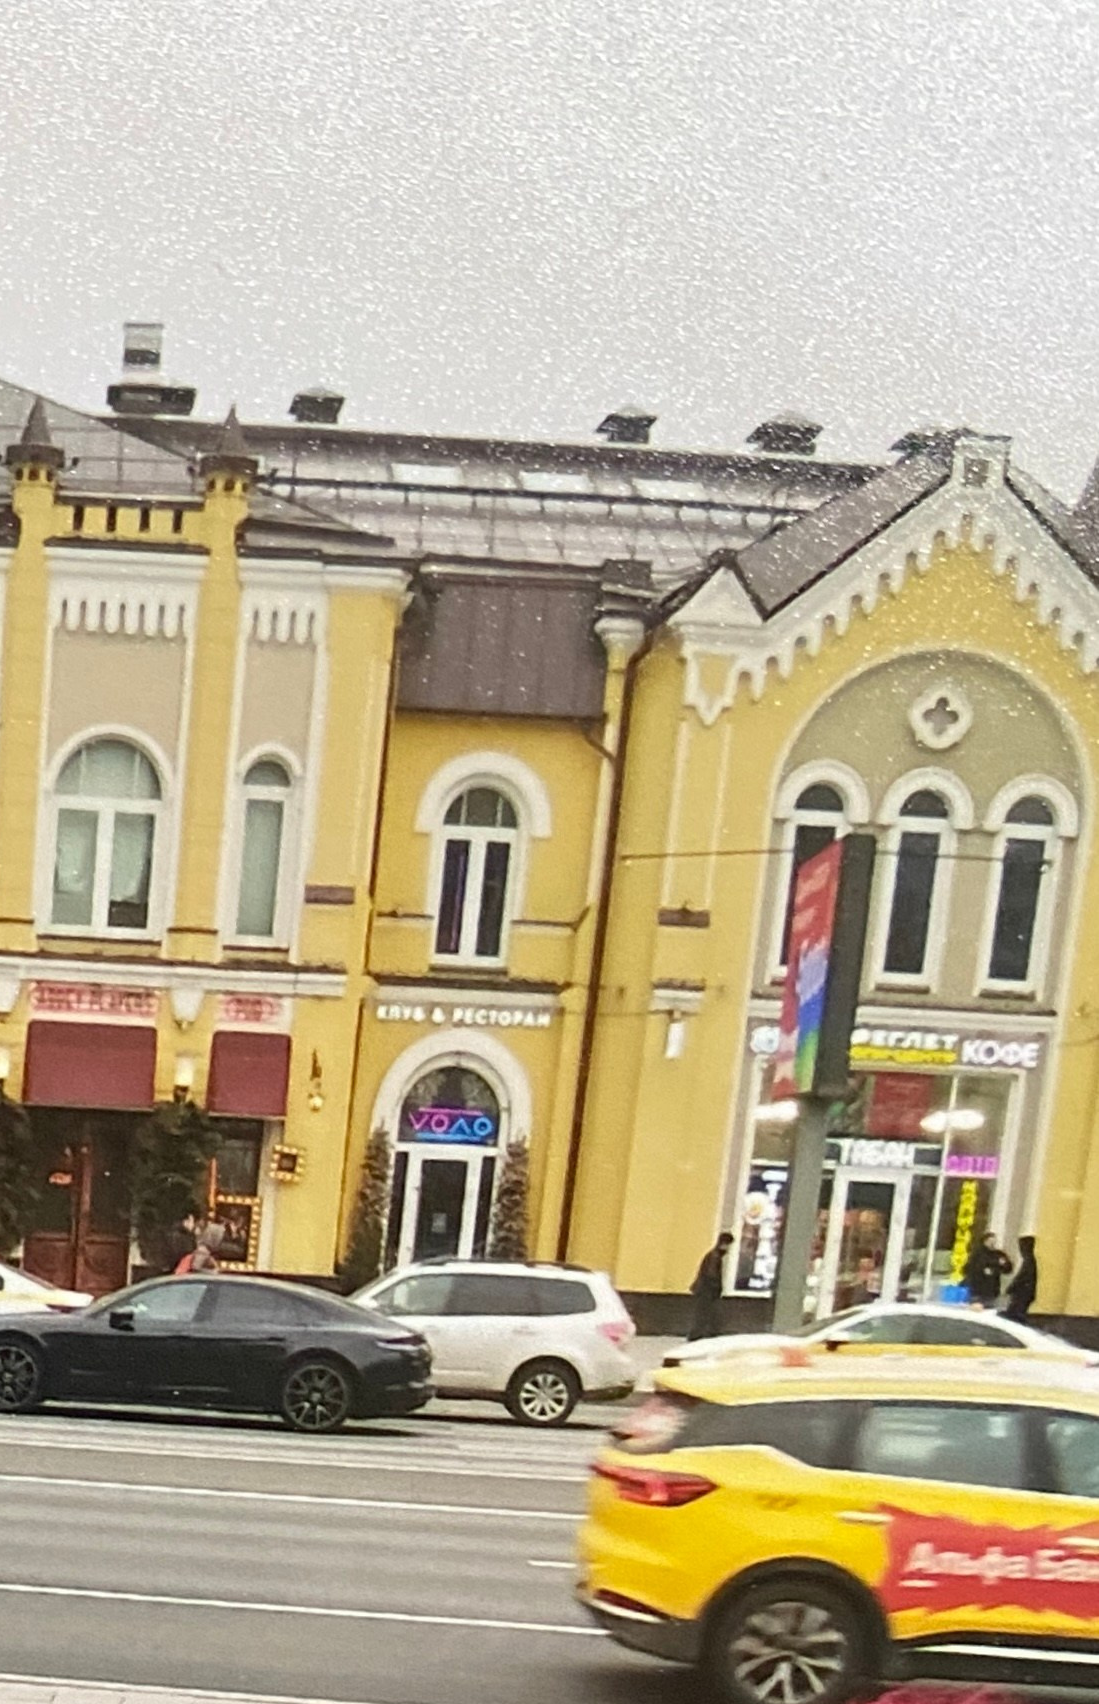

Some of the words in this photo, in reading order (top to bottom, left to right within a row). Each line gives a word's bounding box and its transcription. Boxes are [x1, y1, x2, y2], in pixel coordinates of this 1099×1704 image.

[452, 1006, 551, 1029] РЕСТОРАН
[961, 1038, 1040, 1068] КОФЕ
[902, 1542, 1030, 1586] Альфа
